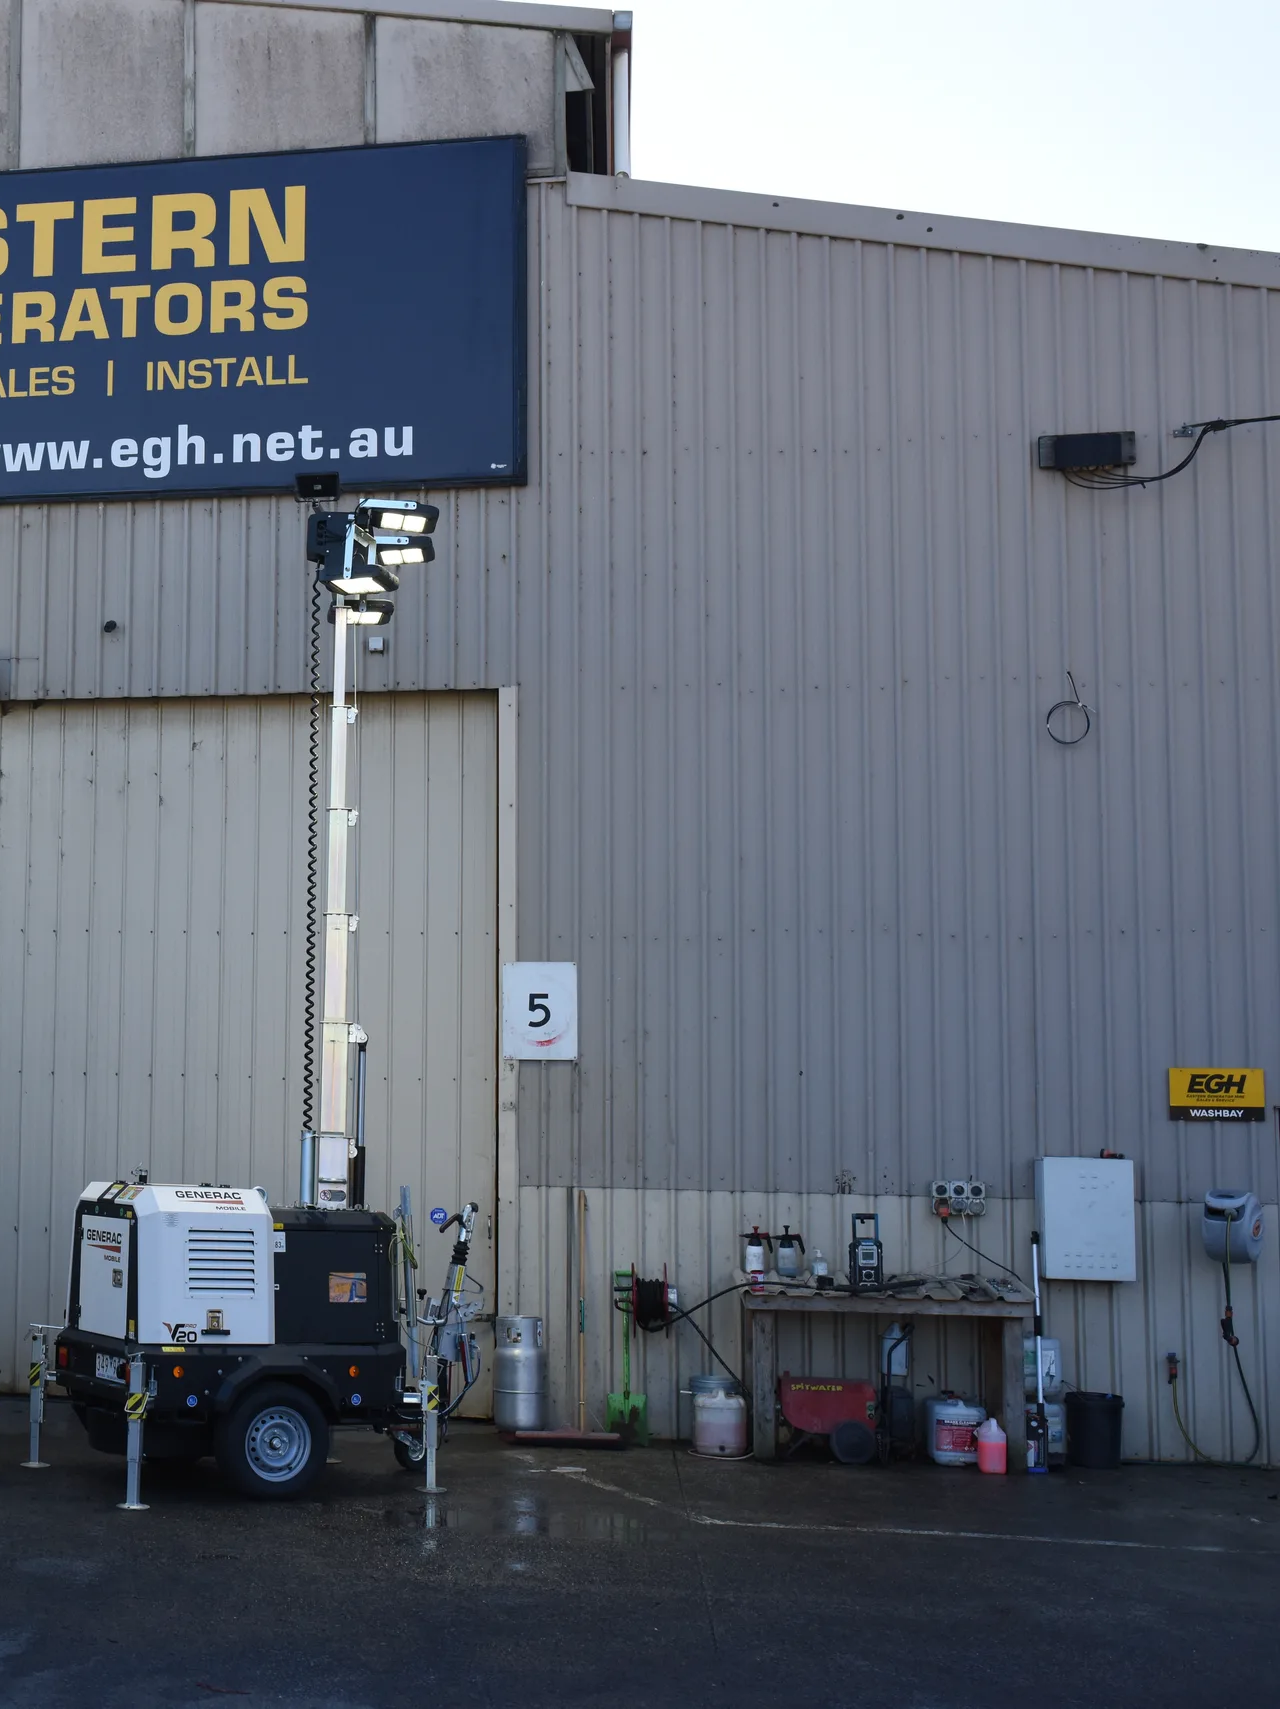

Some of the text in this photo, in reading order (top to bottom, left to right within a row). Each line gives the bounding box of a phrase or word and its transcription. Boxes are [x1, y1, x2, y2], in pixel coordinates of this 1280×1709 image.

[146, 354, 309, 391] INSTALL
[528, 993, 551, 1028] 5
[1187, 1073, 1247, 1094] EGH
[1189, 1108, 1244, 1118] WASHBAY
[175, 1190, 242, 1200] GENERAC
[86, 1228, 122, 1245] GENERAC
[103, 1254, 121, 1263] MOBILE
